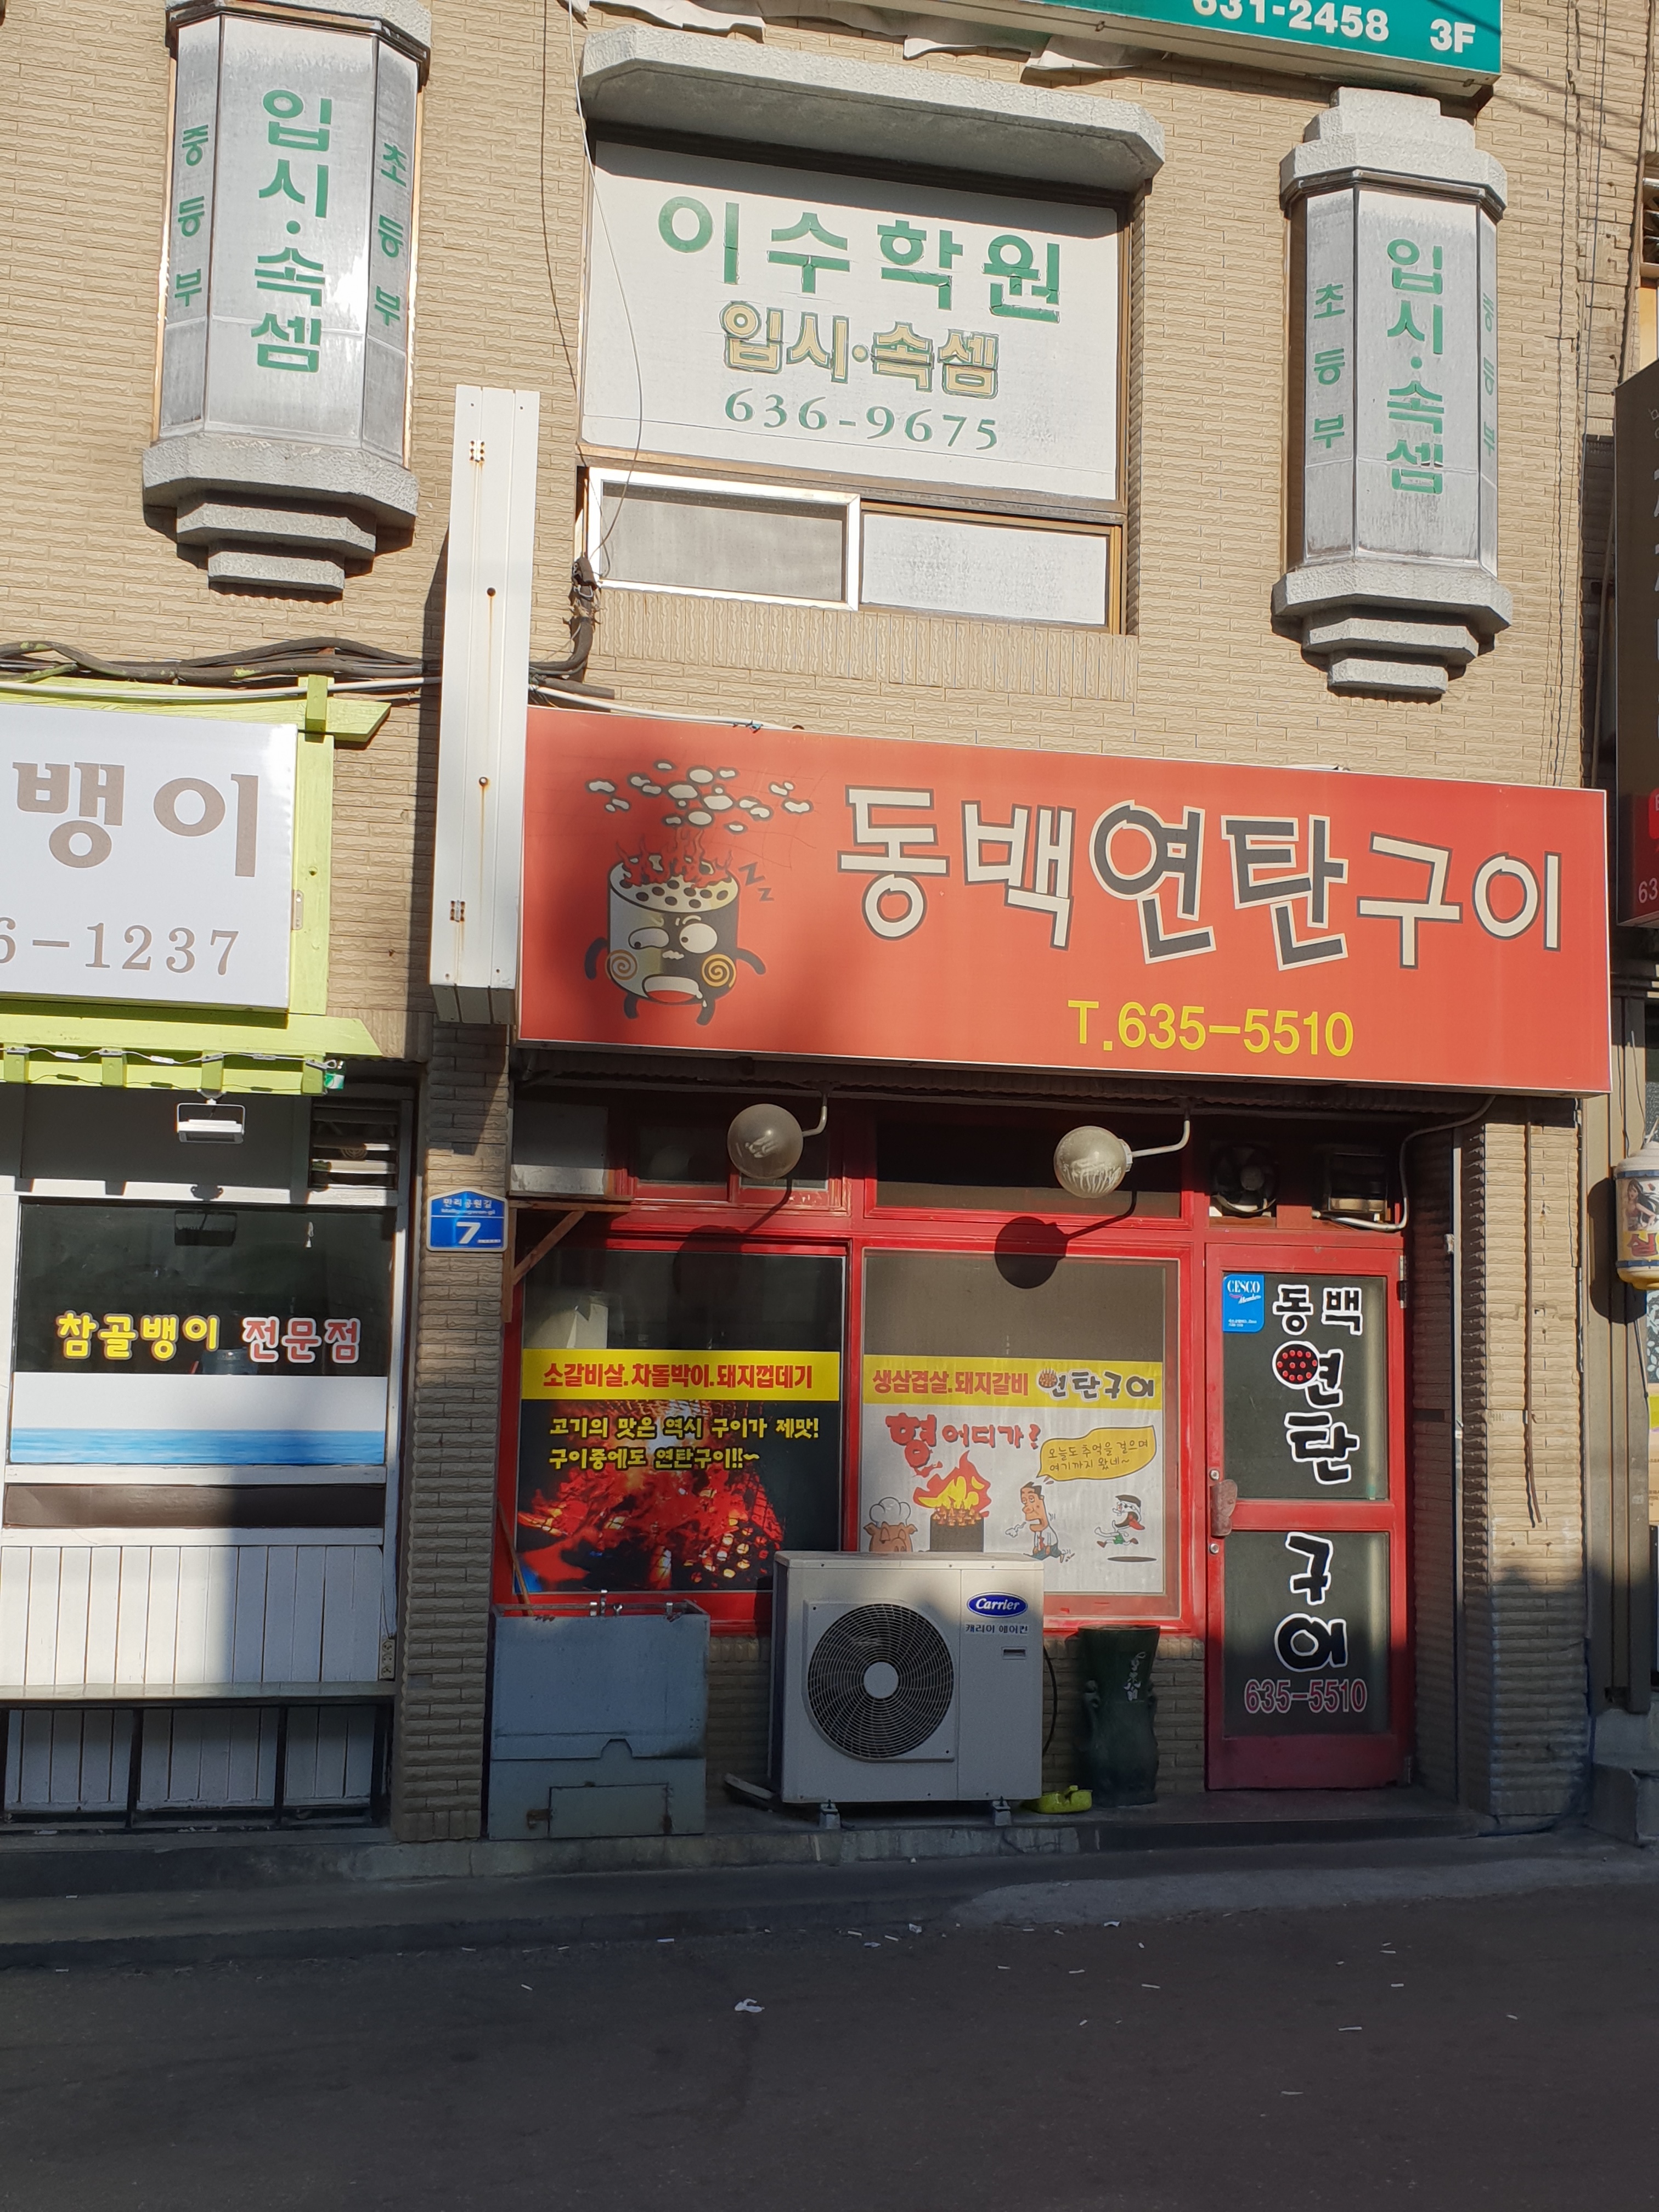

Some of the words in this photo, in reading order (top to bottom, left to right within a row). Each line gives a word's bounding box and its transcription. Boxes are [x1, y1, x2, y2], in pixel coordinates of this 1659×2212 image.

[1430, 19, 1476, 53] 3F
[174, 125, 209, 307] 중등부
[375, 141, 408, 326] 초등부
[658, 196, 1061, 324] 이수학원
[1313, 284, 1346, 448] 초등부
[725, 388, 998, 450] 636-9675
[12, 761, 258, 878] 뱅이
[837, 784, 1562, 971] 동백연탄구이
[1068, 1000, 1355, 1057] T.635-5510
[456, 1222, 481, 1244] 7
[1227, 1280, 1260, 1293] CESCO
[1273, 1284, 1362, 1335] 동백
[57, 1311, 220, 1362] 참골뱅이
[242, 1316, 360, 1364] 전문점
[955, 1372, 1029, 1396] 돼지갈비
[549, 1417, 609, 1438] 고기의
[616, 1417, 656, 1438] 맛은
[664, 1417, 703, 1438] 역시
[712, 1417, 768, 1438] 구이가
[775, 1417, 819, 1439] 제맛!
[941, 1424, 1041, 1449] 어디가?
[549, 1447, 646, 1470] 구이중에도
[1048, 1447, 1078, 1461] 오늘도
[1082, 1442, 1112, 1458] 추억을
[1049, 1459, 1093, 1471] 여기까지
[976, 1598, 1020, 1610] Carrier
[1244, 1679, 1368, 1714] 635-5510
